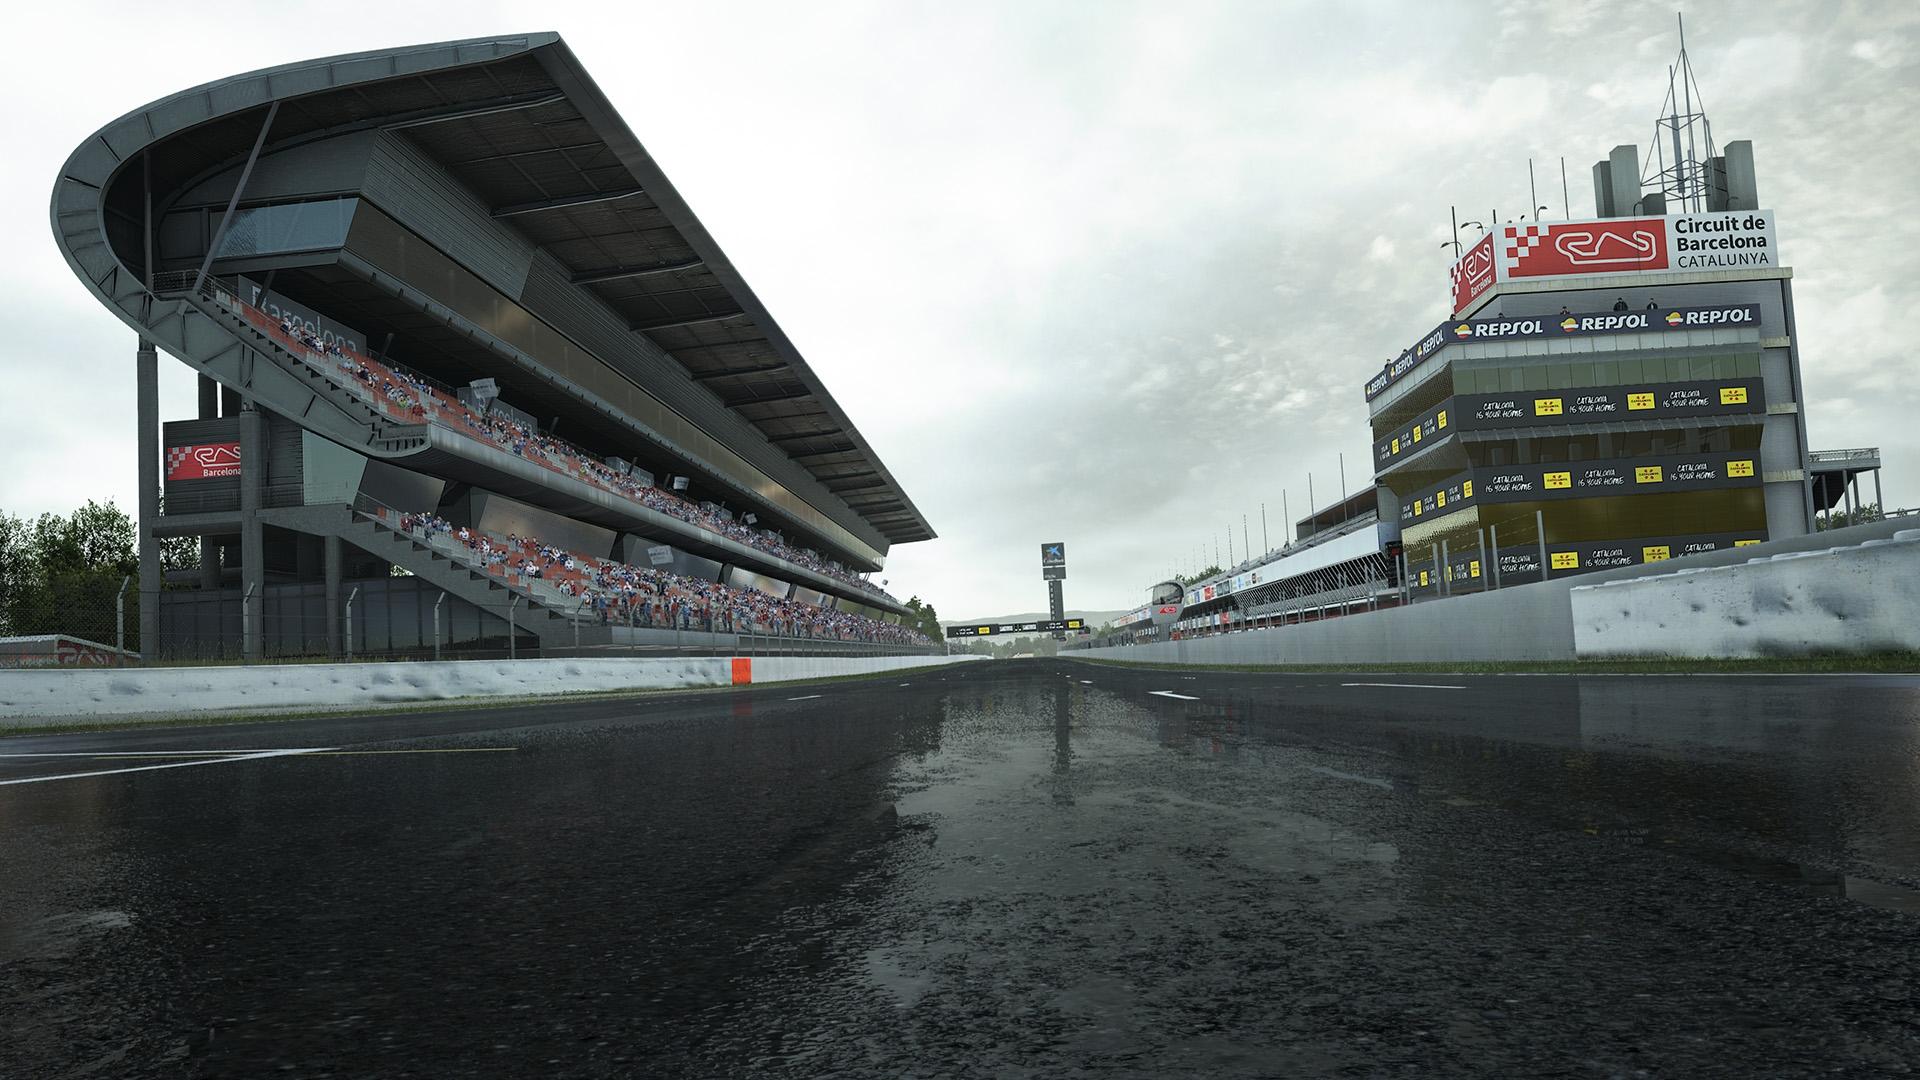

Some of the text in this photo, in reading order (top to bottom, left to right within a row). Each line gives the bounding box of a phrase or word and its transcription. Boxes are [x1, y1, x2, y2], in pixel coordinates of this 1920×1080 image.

[1675, 215, 1765, 234] Circuit de
[1677, 234, 1767, 251] Barcelona
[1678, 252, 1769, 268] CATALUNYA
[1582, 314, 1648, 330] REPSOL
[1686, 308, 1752, 325] REPSOL
[1475, 320, 1543, 337] REPSOL
[1422, 329, 1444, 355] REPSOL
[1395, 353, 1414, 376] REPSOL
[1595, 403, 1617, 412] HOME
[1688, 397, 1709, 407] HOME
[1502, 408, 1524, 418] HOME
[1603, 476, 1625, 485] HOME
[1696, 470, 1717, 479] HOME
[1511, 482, 1533, 491] HOME
[1610, 556, 1632, 565] HOME
